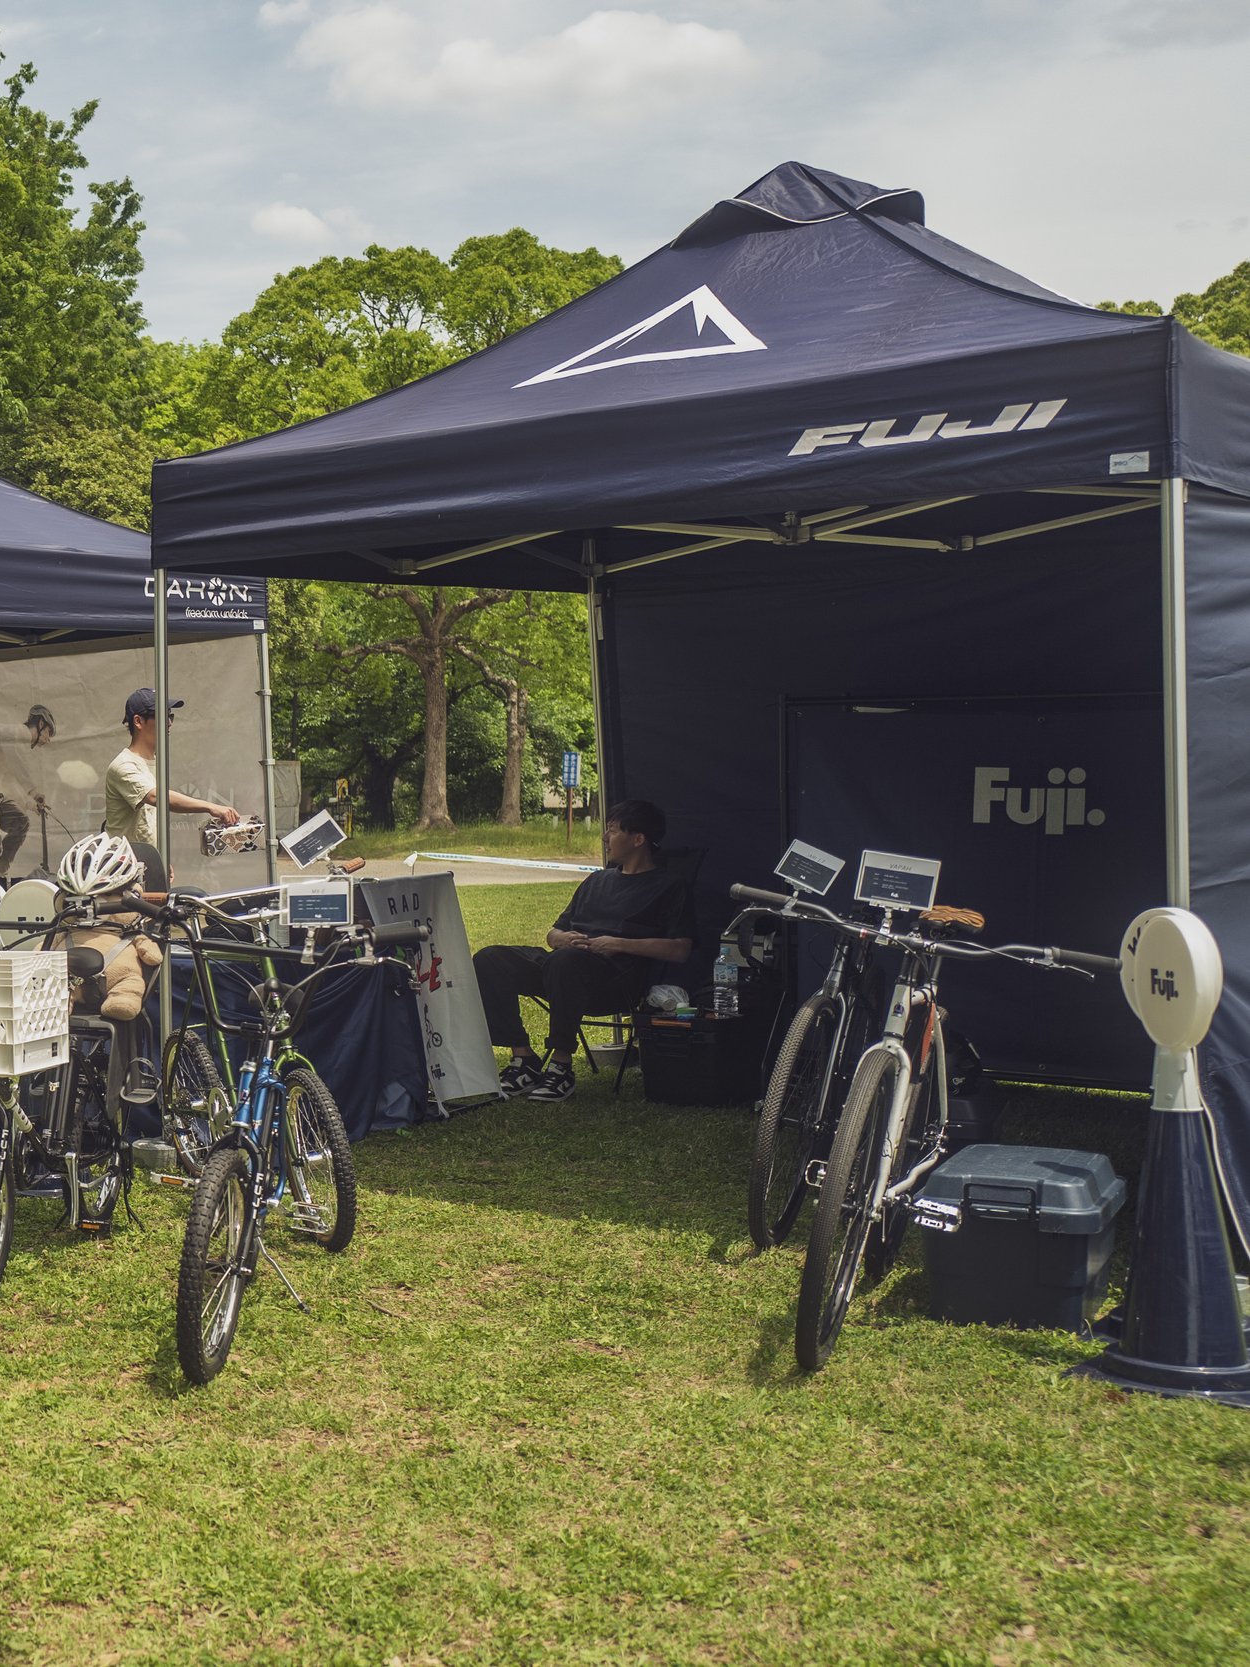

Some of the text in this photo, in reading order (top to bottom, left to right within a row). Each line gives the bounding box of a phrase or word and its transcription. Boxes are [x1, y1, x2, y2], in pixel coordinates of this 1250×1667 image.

[787, 398, 1068, 456] FUJI
[185, 606, 220, 618] freedom
[972, 767, 1106, 835] Fuji.
[387, 893, 420, 915] RAD
[1150, 968, 1179, 1001] Fuji.
[0, 1128, 10, 1171] FUJI
[252, 1172, 265, 1220] FUJI
